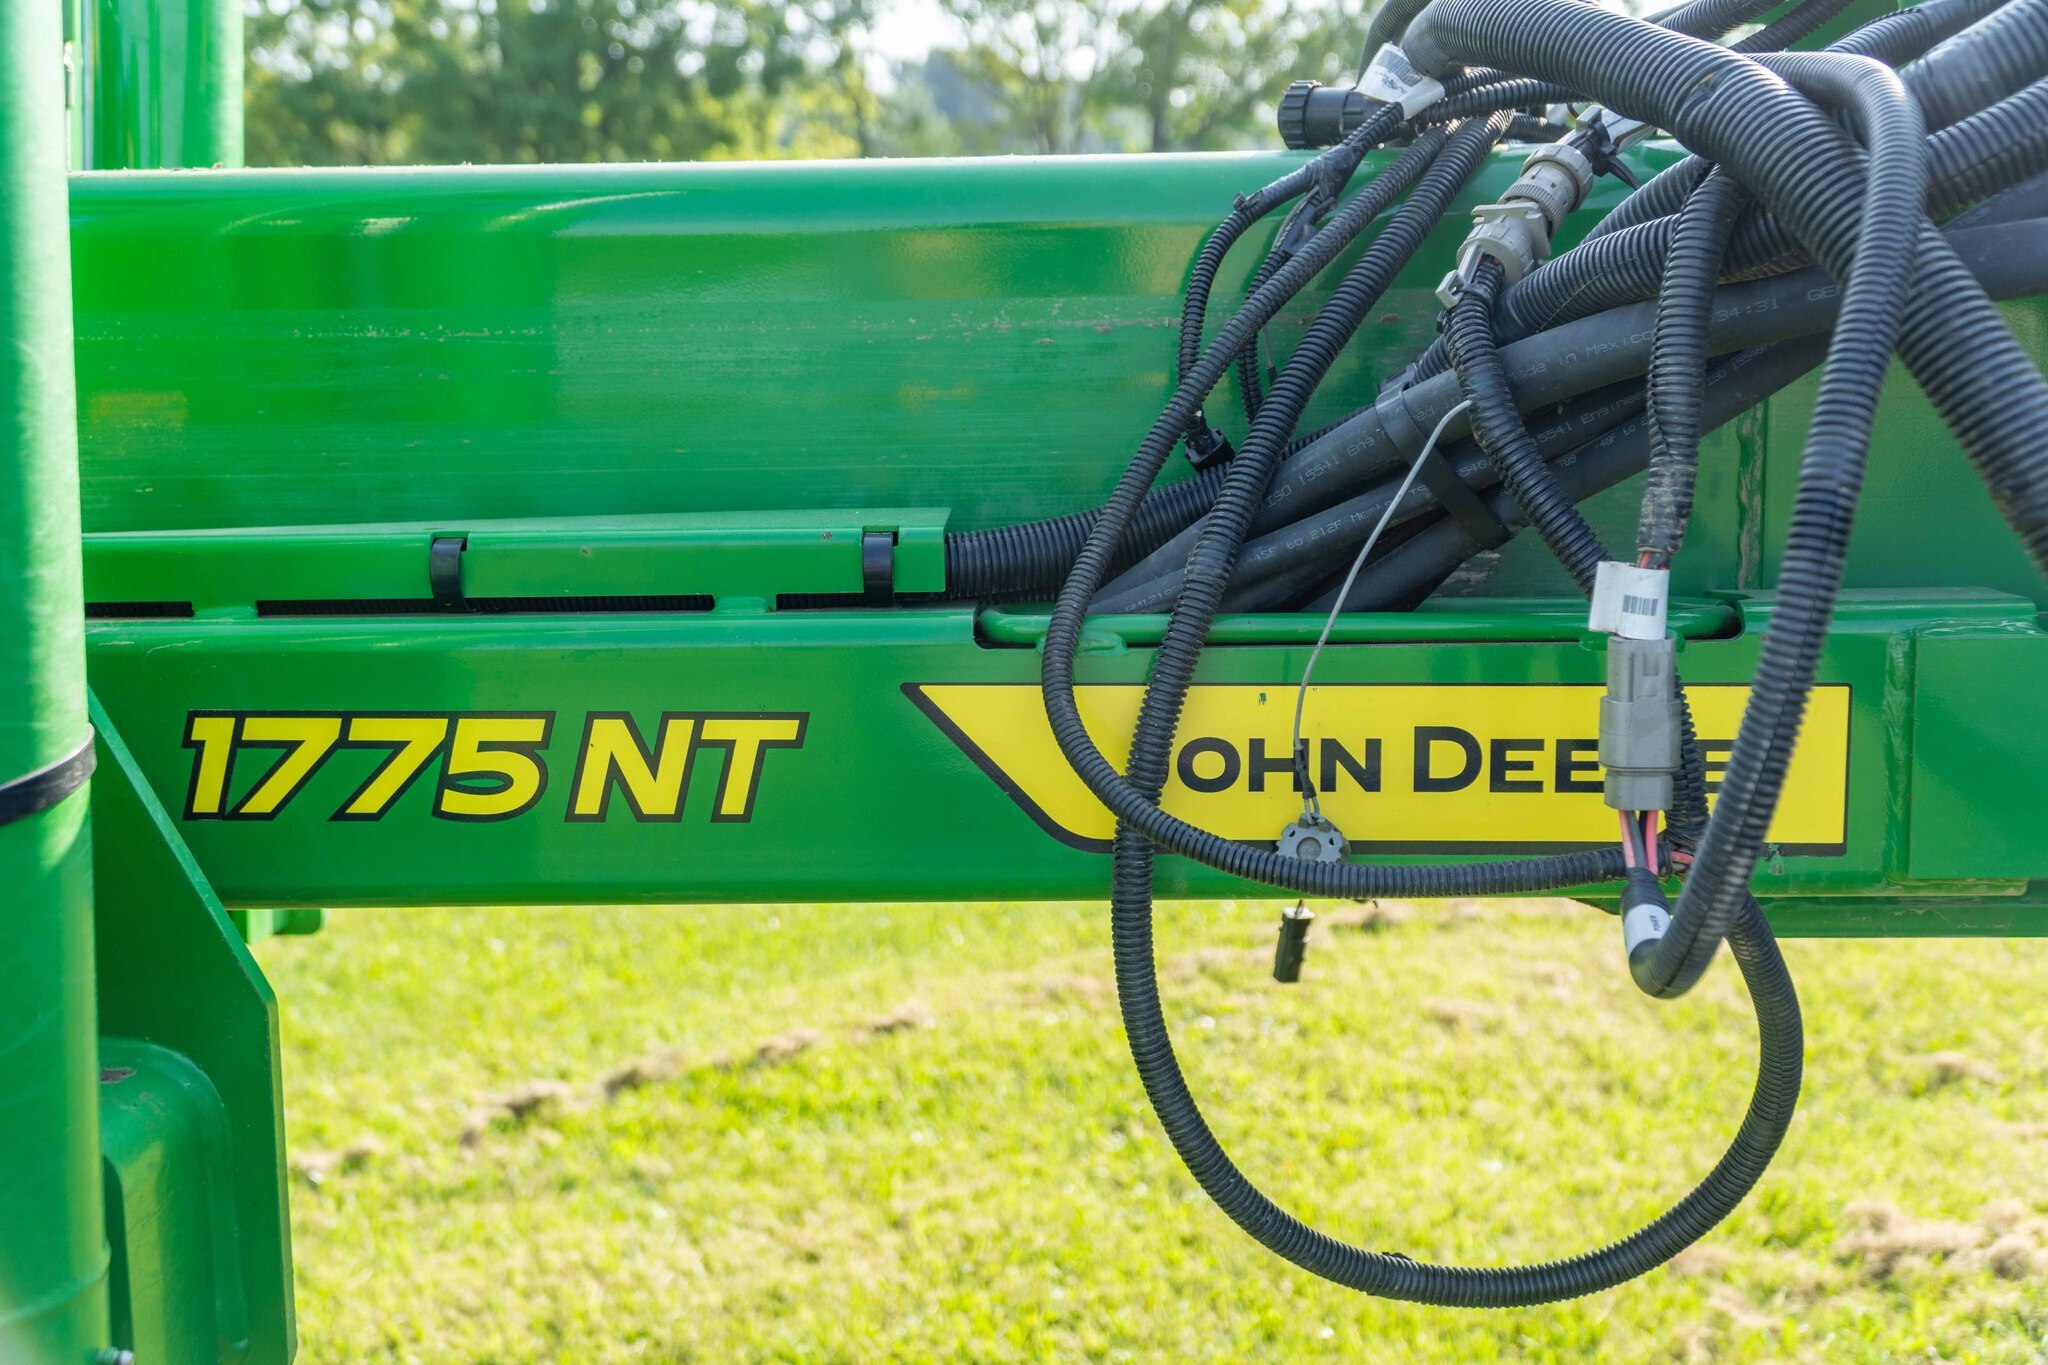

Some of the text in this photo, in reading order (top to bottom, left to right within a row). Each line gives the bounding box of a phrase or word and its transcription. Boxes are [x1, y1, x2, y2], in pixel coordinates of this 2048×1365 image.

[183, 710, 810, 823] 1775 NT
[1177, 736, 1383, 793] OHN
